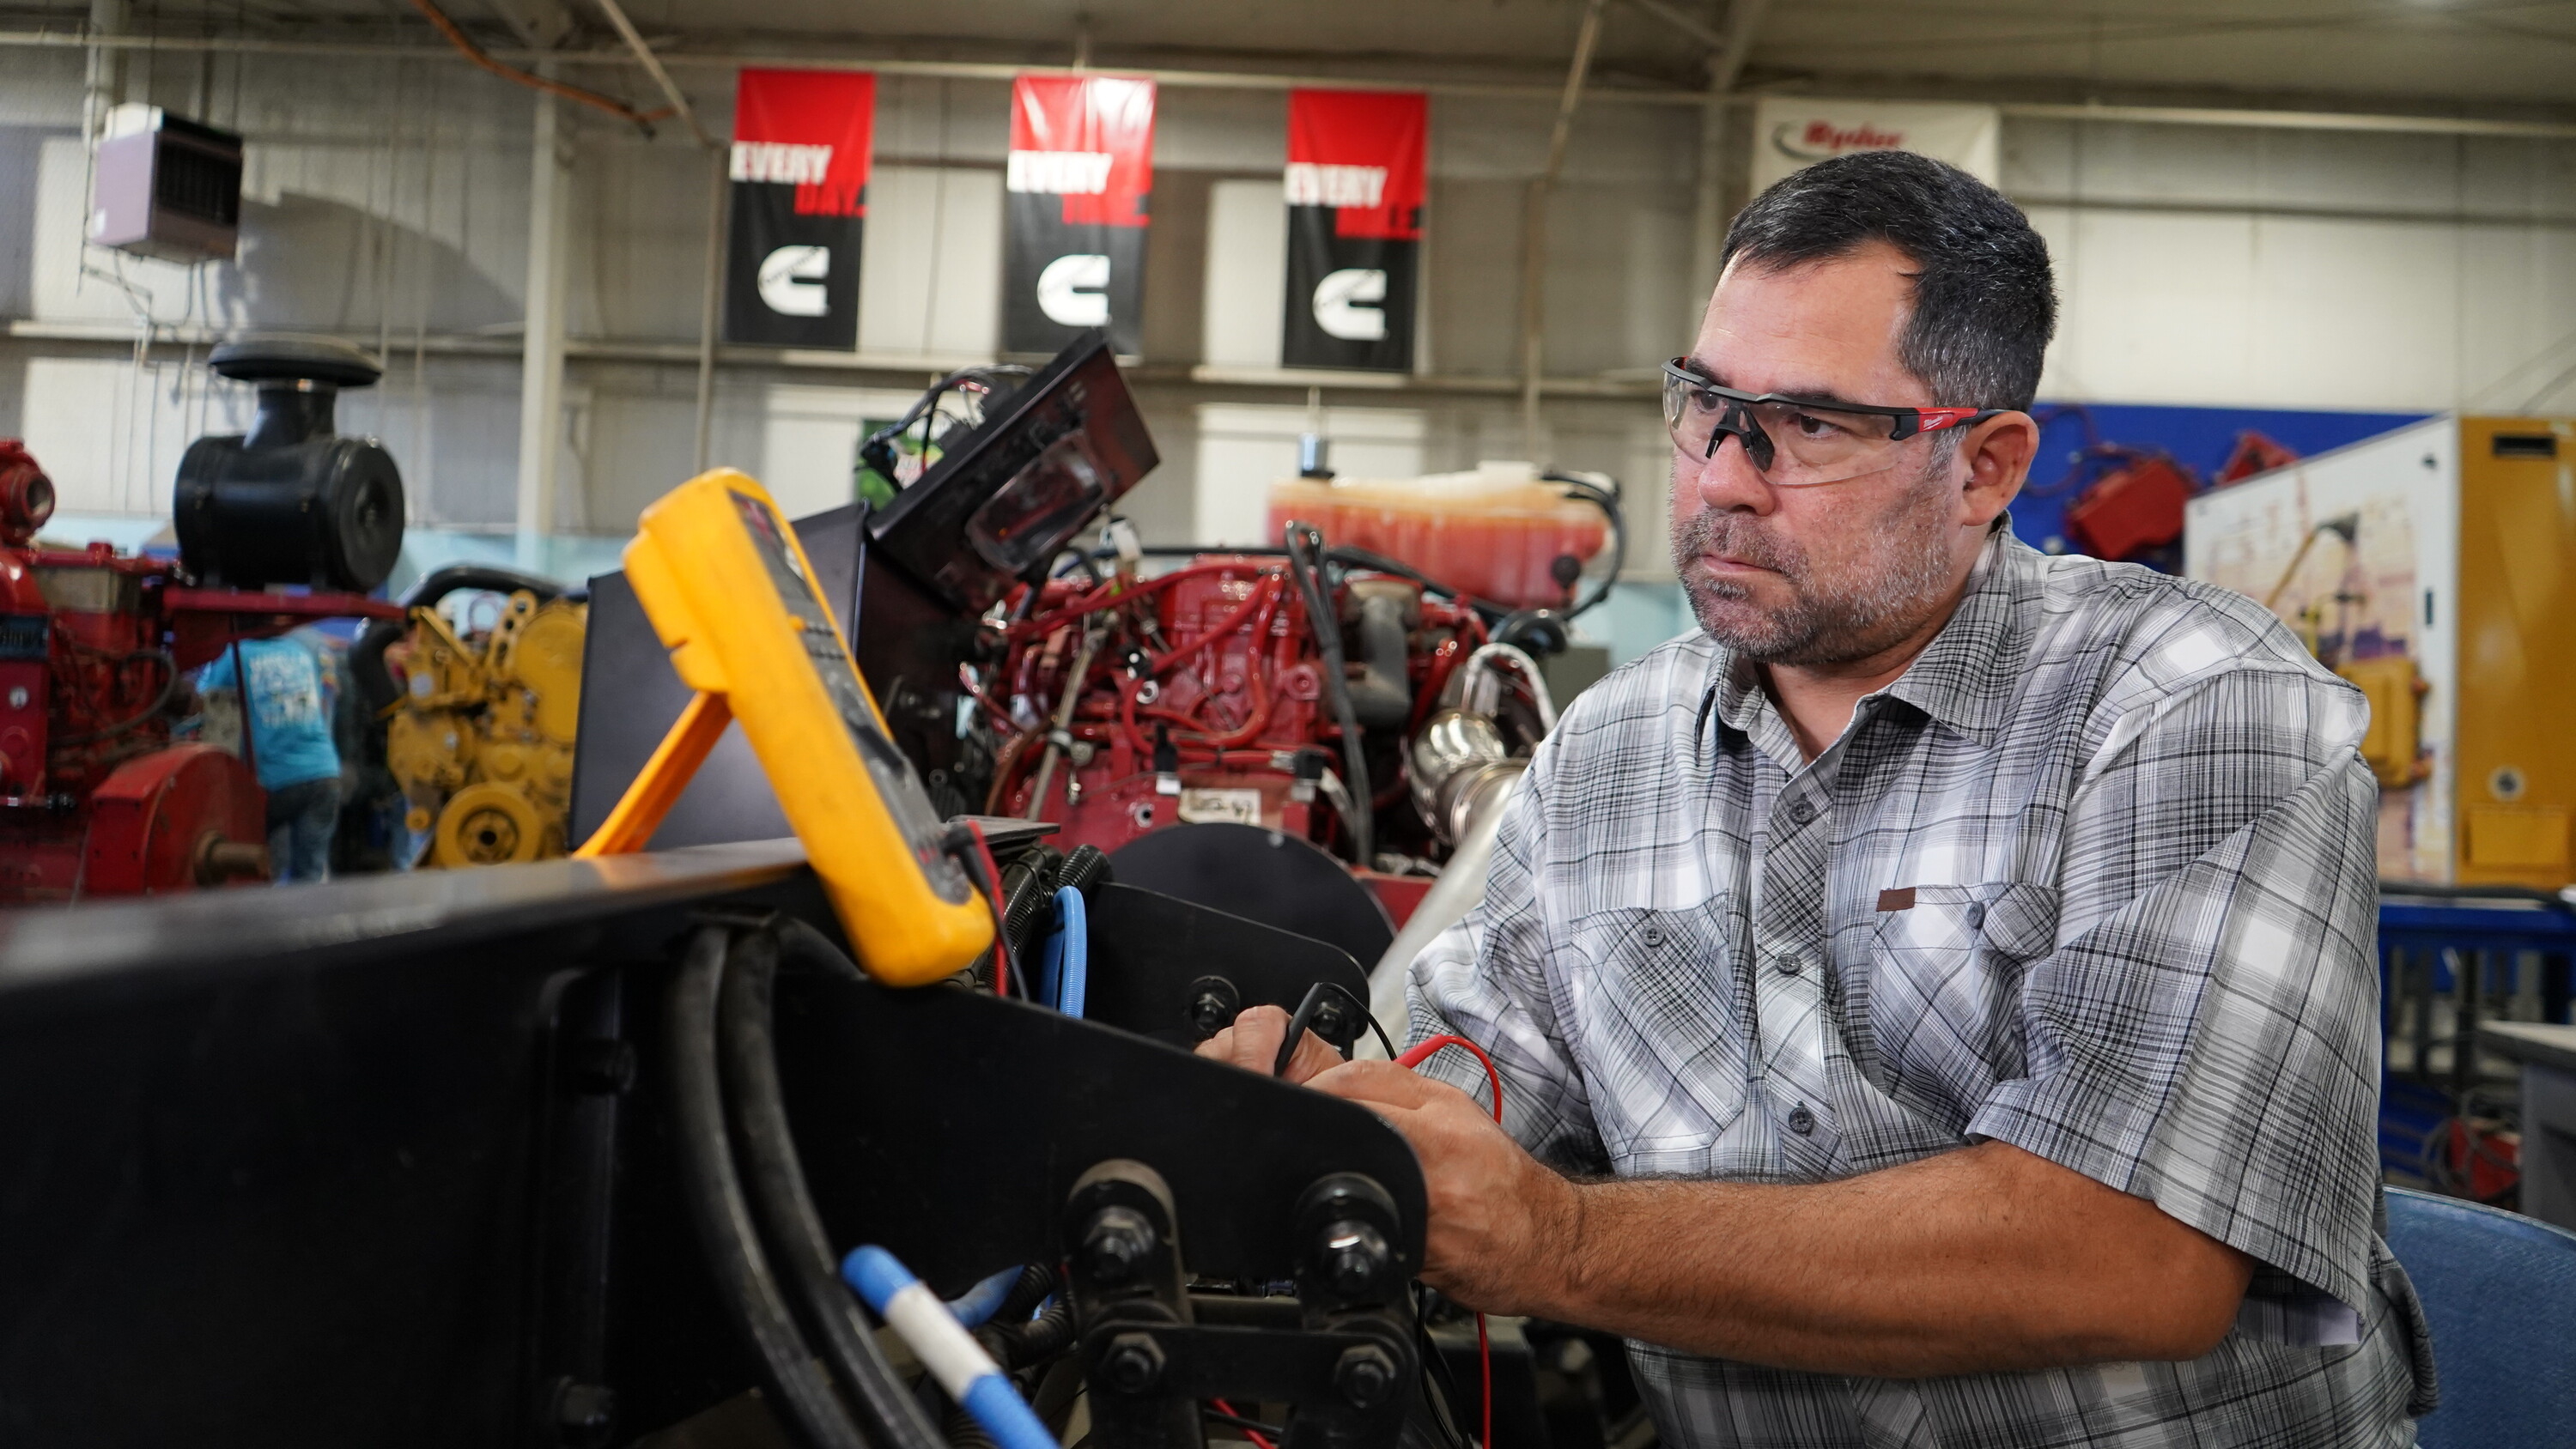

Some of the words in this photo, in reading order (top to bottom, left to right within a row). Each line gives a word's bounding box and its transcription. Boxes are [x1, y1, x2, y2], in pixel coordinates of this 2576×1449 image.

[730, 141, 833, 185] EVERY
[1006, 149, 1114, 195] EVERY
[1285, 161, 1388, 209] EVERY
